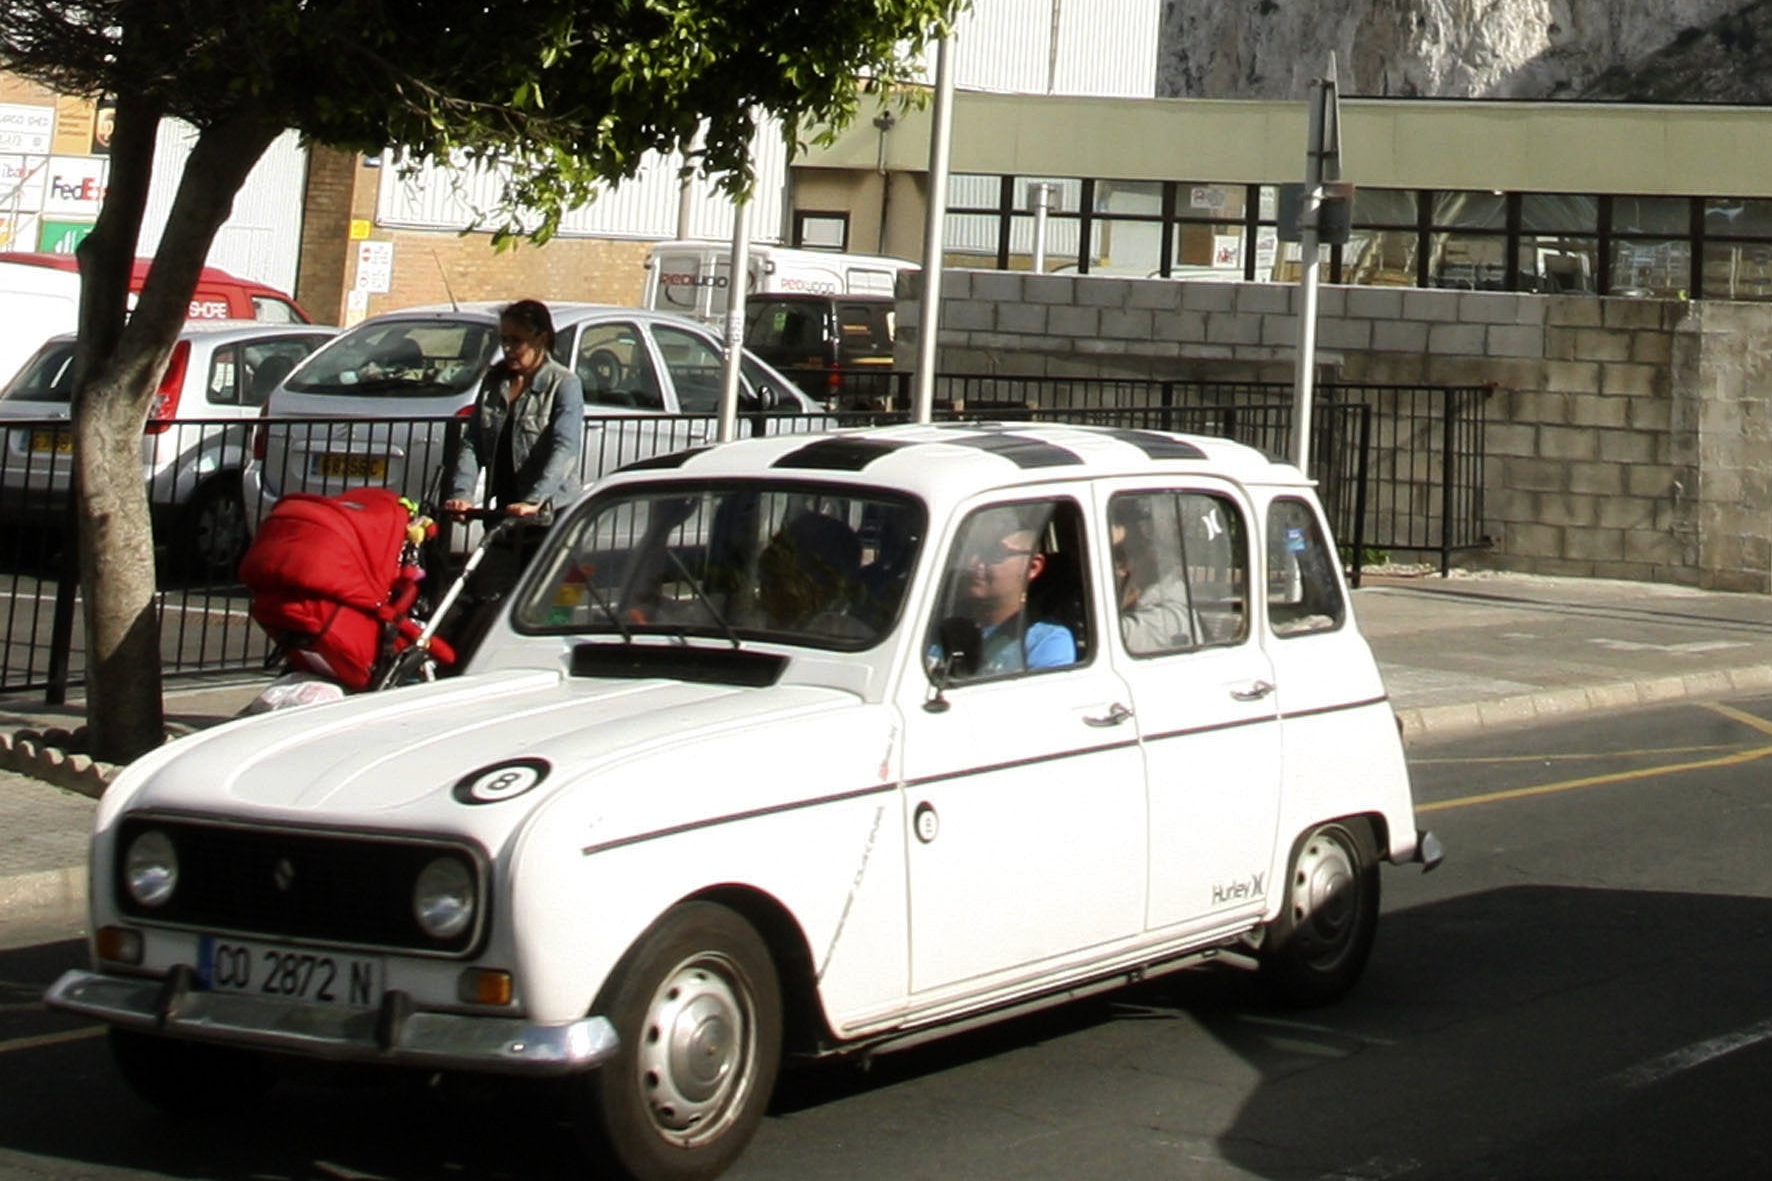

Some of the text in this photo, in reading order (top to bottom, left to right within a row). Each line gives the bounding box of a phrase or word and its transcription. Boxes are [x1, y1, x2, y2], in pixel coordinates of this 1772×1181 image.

[660, 273, 728, 288] REDWOO
[487, 772, 522, 790] 8
[1211, 880, 1251, 905] Hurley
[216, 944, 372, 1004] CO 2872 N
